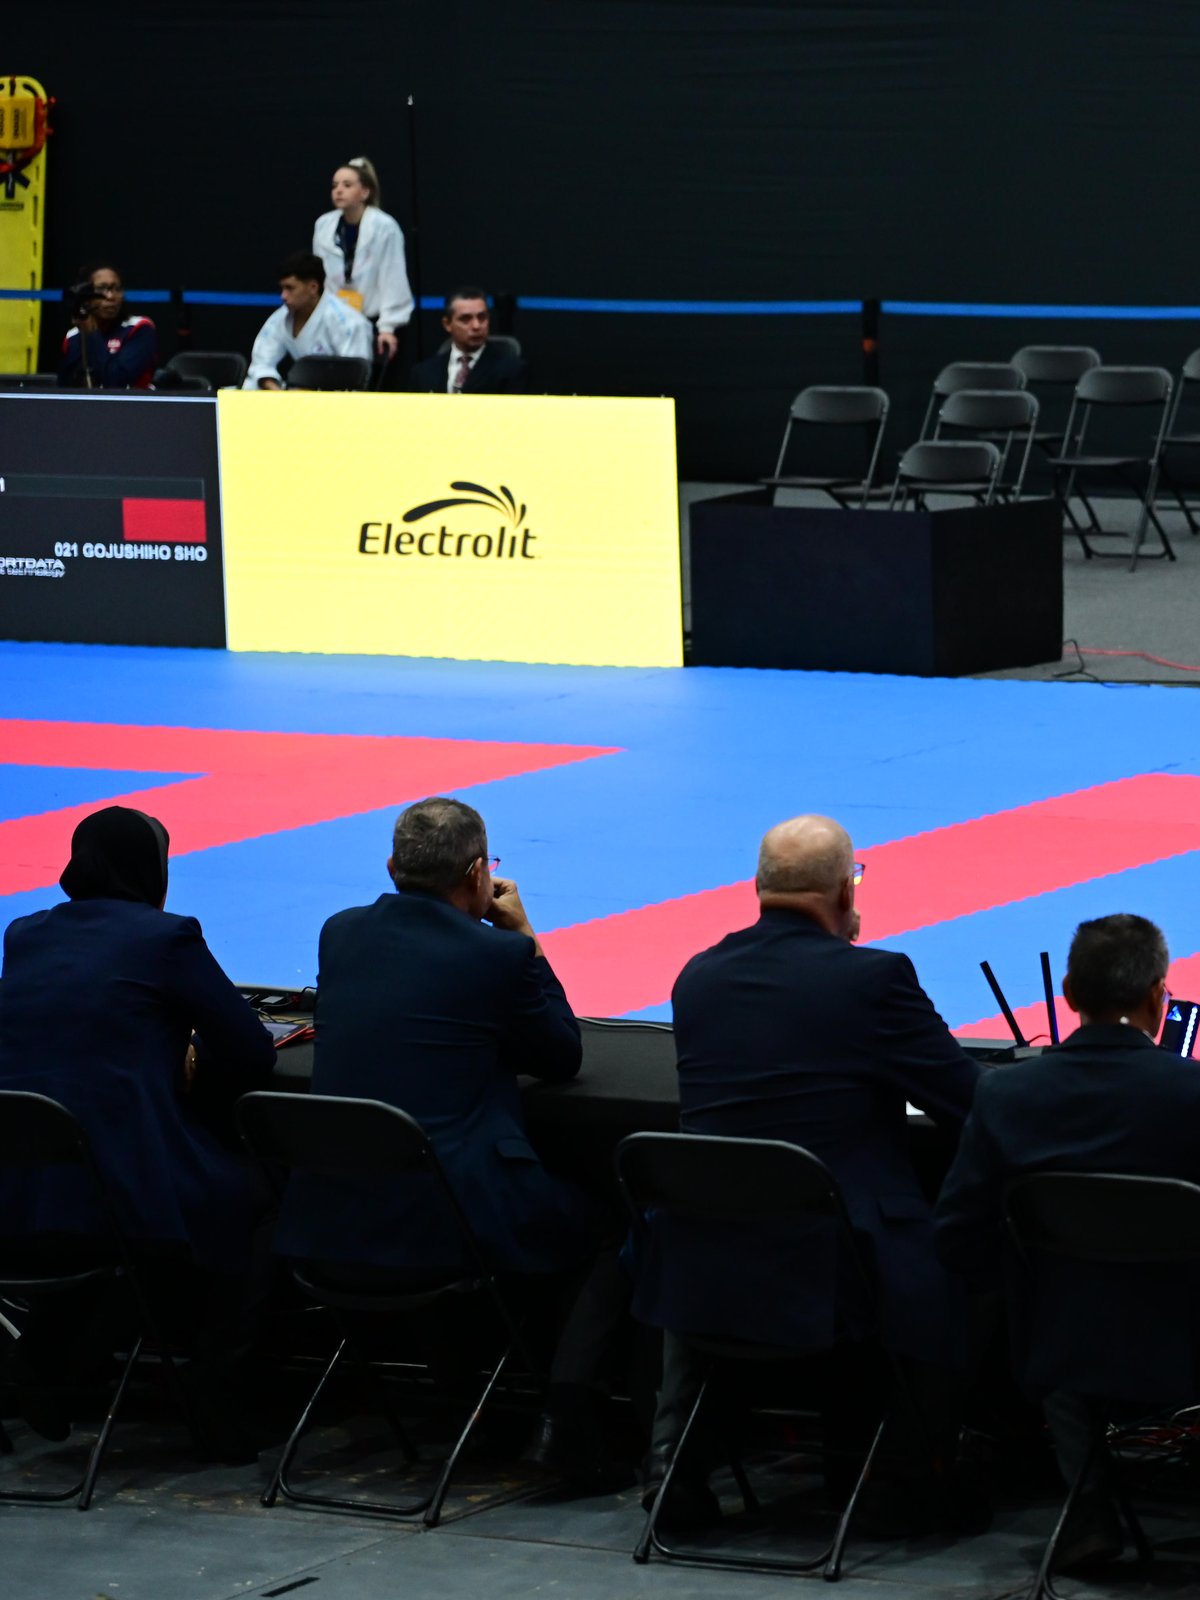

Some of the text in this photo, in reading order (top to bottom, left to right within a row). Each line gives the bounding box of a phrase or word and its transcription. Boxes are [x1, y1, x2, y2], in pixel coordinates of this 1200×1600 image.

[54, 541, 208, 562] 021 GOJUSHIHO SHO
[358, 522, 537, 559] Electrolit
